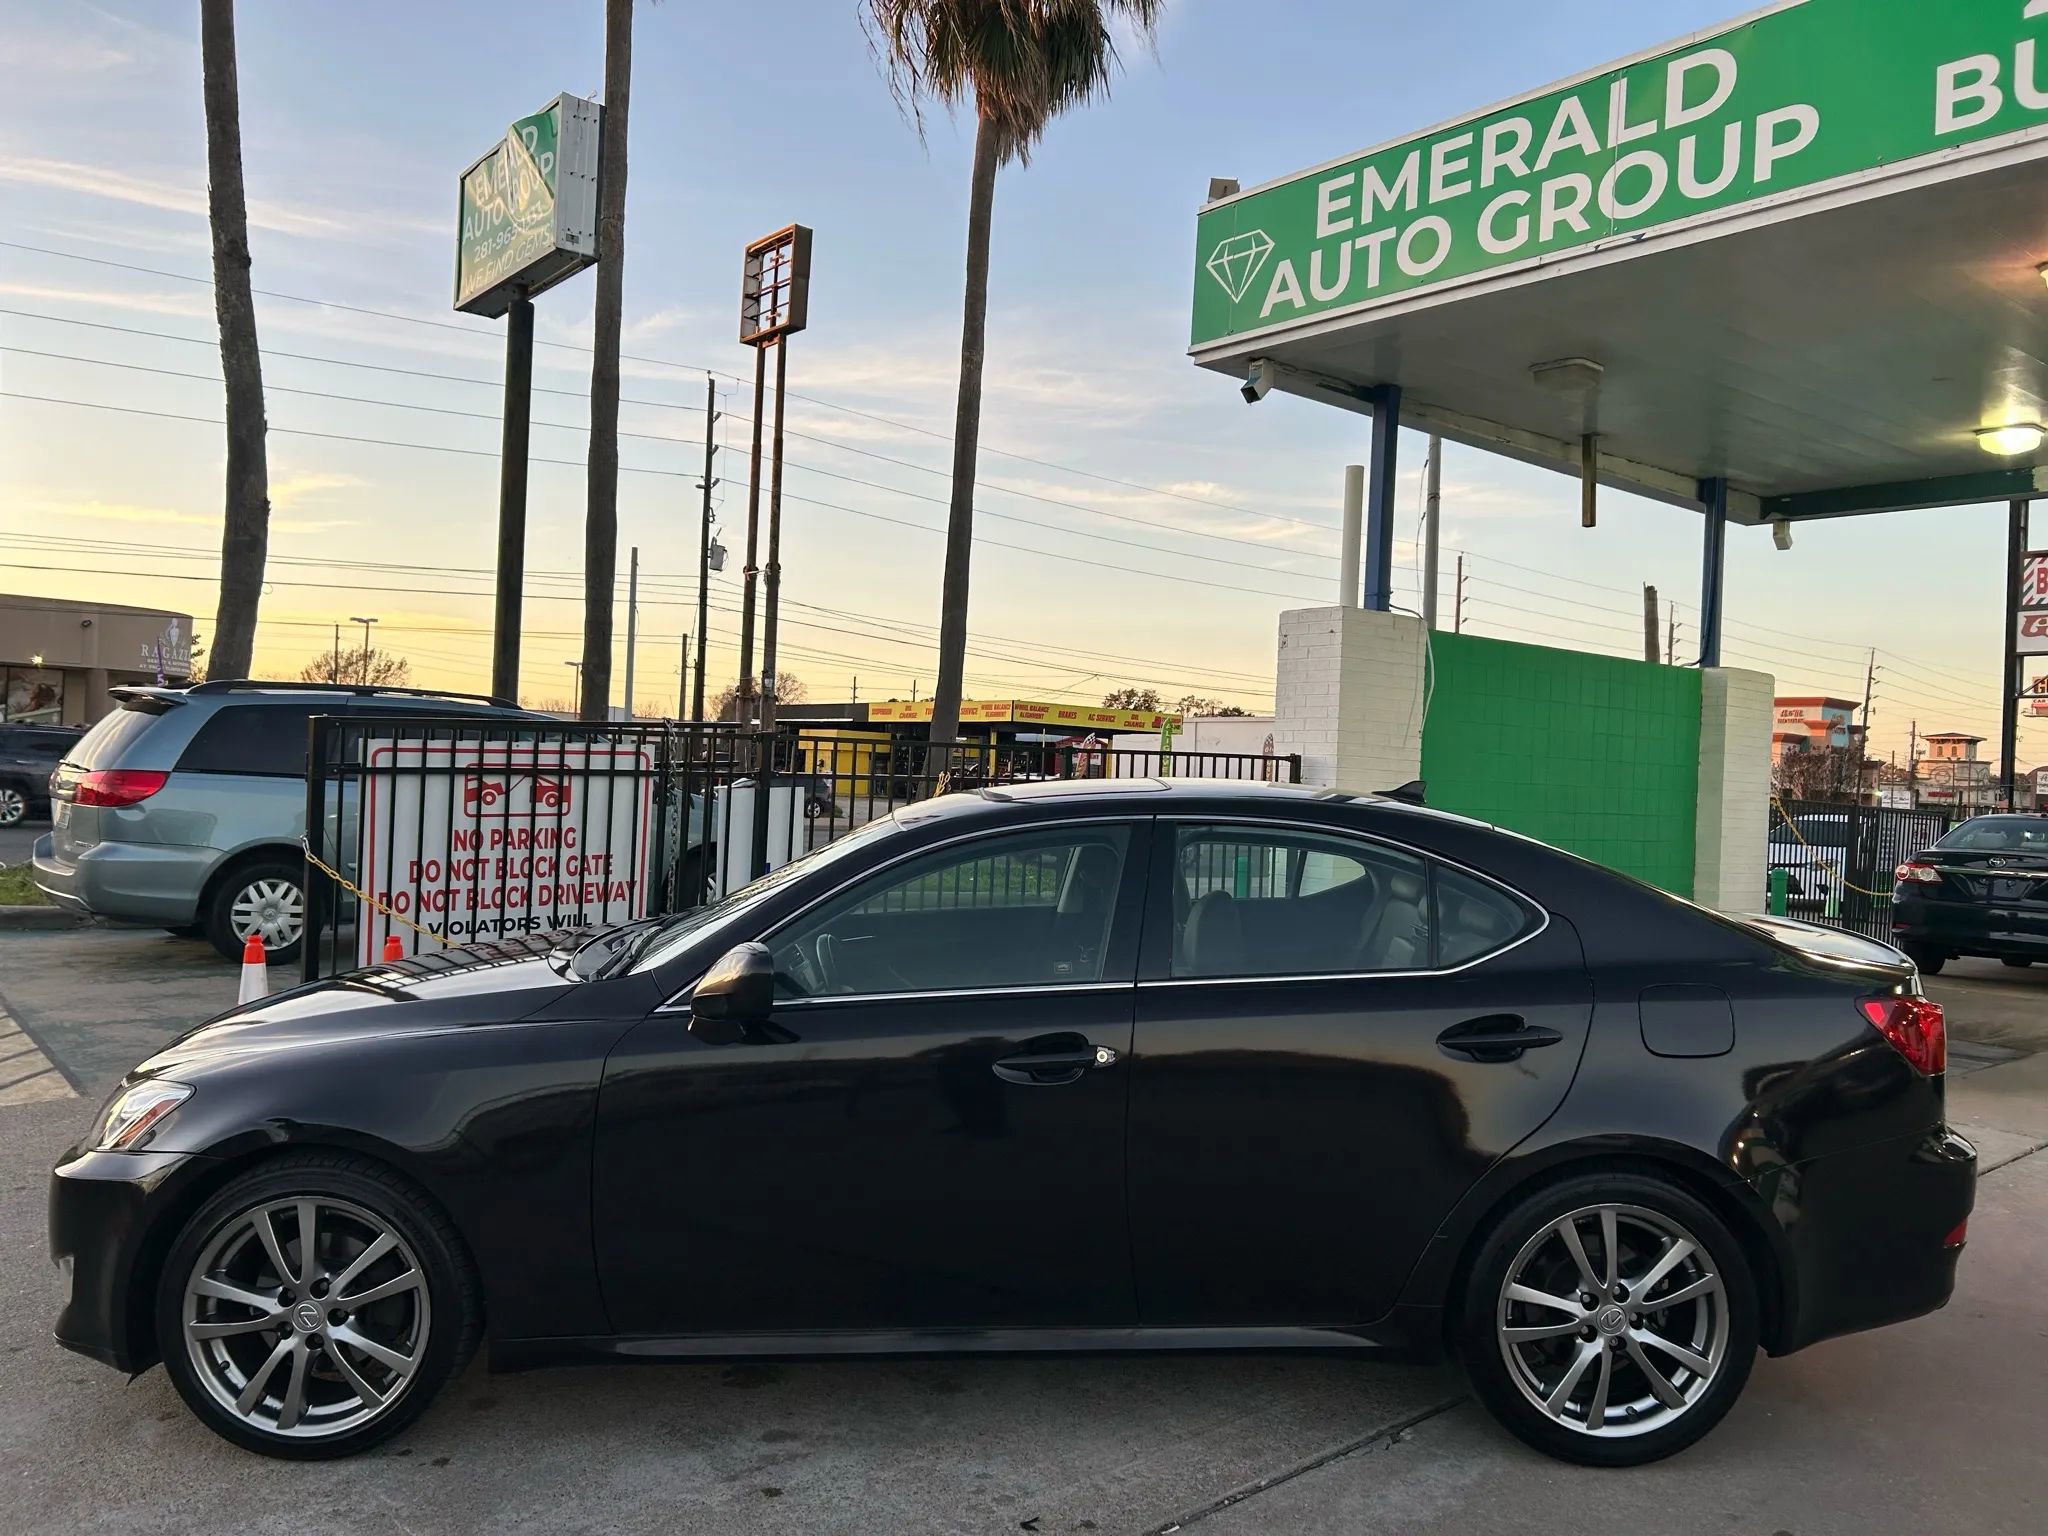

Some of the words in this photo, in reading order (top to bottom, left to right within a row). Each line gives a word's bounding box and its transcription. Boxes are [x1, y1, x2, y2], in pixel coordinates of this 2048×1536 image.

[1316, 48, 1738, 239] EMERALD
[475, 125, 539, 207] EMEALD
[462, 196, 506, 246] AUTO
[1259, 215, 1452, 319] AUTO
[1477, 104, 1820, 254] GROUP
[485, 249, 514, 285] FIND
[1057, 710, 1077, 720] BRAKES
[1096, 713, 1116, 723] SERVICE
[453, 828, 484, 852] NO
[490, 827, 577, 851] PARKING
[409, 859, 441, 884] DO
[450, 858, 490, 882] NOT
[495, 855, 560, 880] BLOCK
[565, 853, 613, 877] GATE
[378, 890, 410, 915] DO
[418, 888, 461, 913] NOT
[466, 884, 533, 910] BLOCK
[538, 880, 637, 906] DRIVEWAY
[427, 915, 541, 936] VOLATORS
